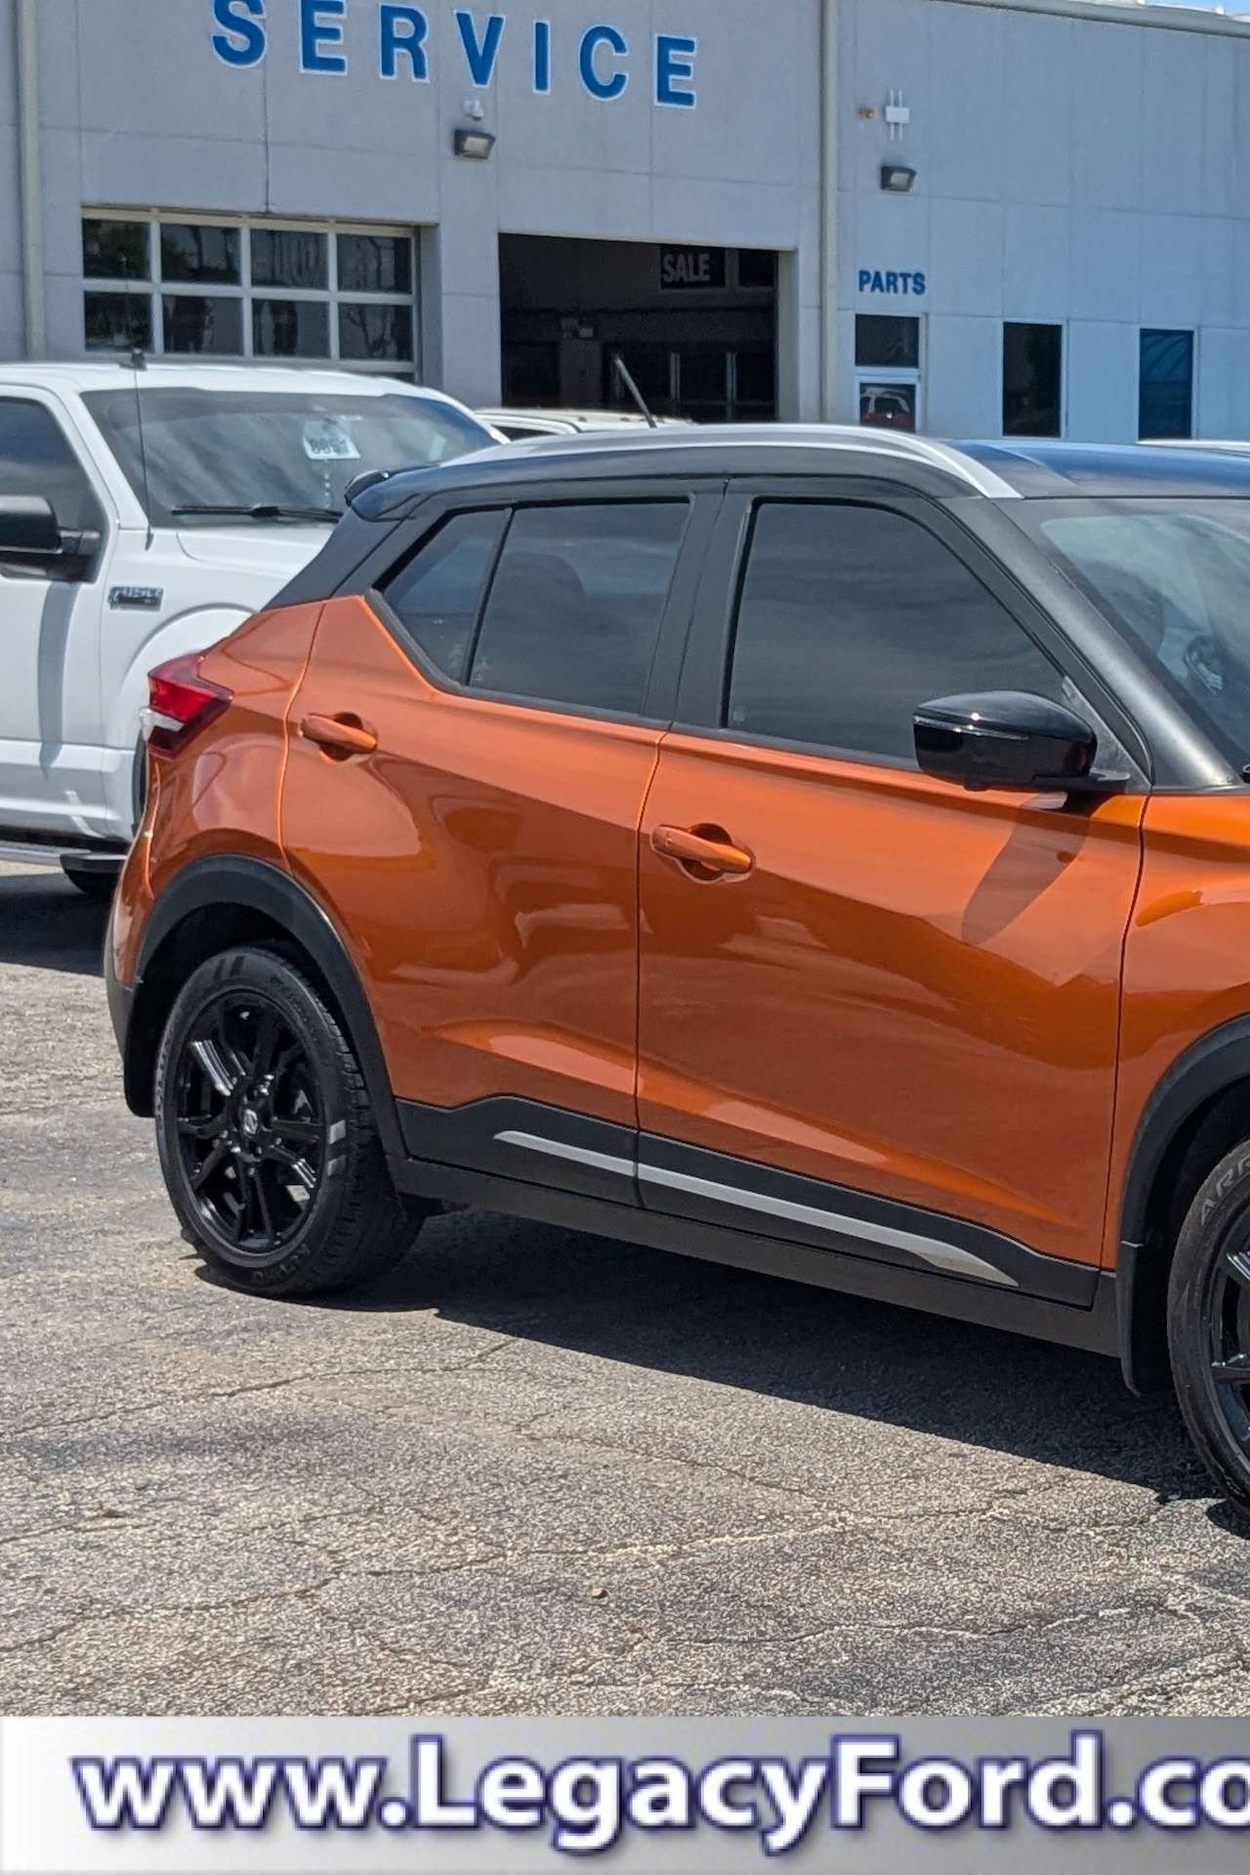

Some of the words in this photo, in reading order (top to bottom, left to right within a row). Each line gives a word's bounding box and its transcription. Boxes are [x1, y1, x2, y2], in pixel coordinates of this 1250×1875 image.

[212, 0, 697, 109] SERVICE
[663, 252, 711, 282] SALE
[858, 269, 926, 296] PARTS
